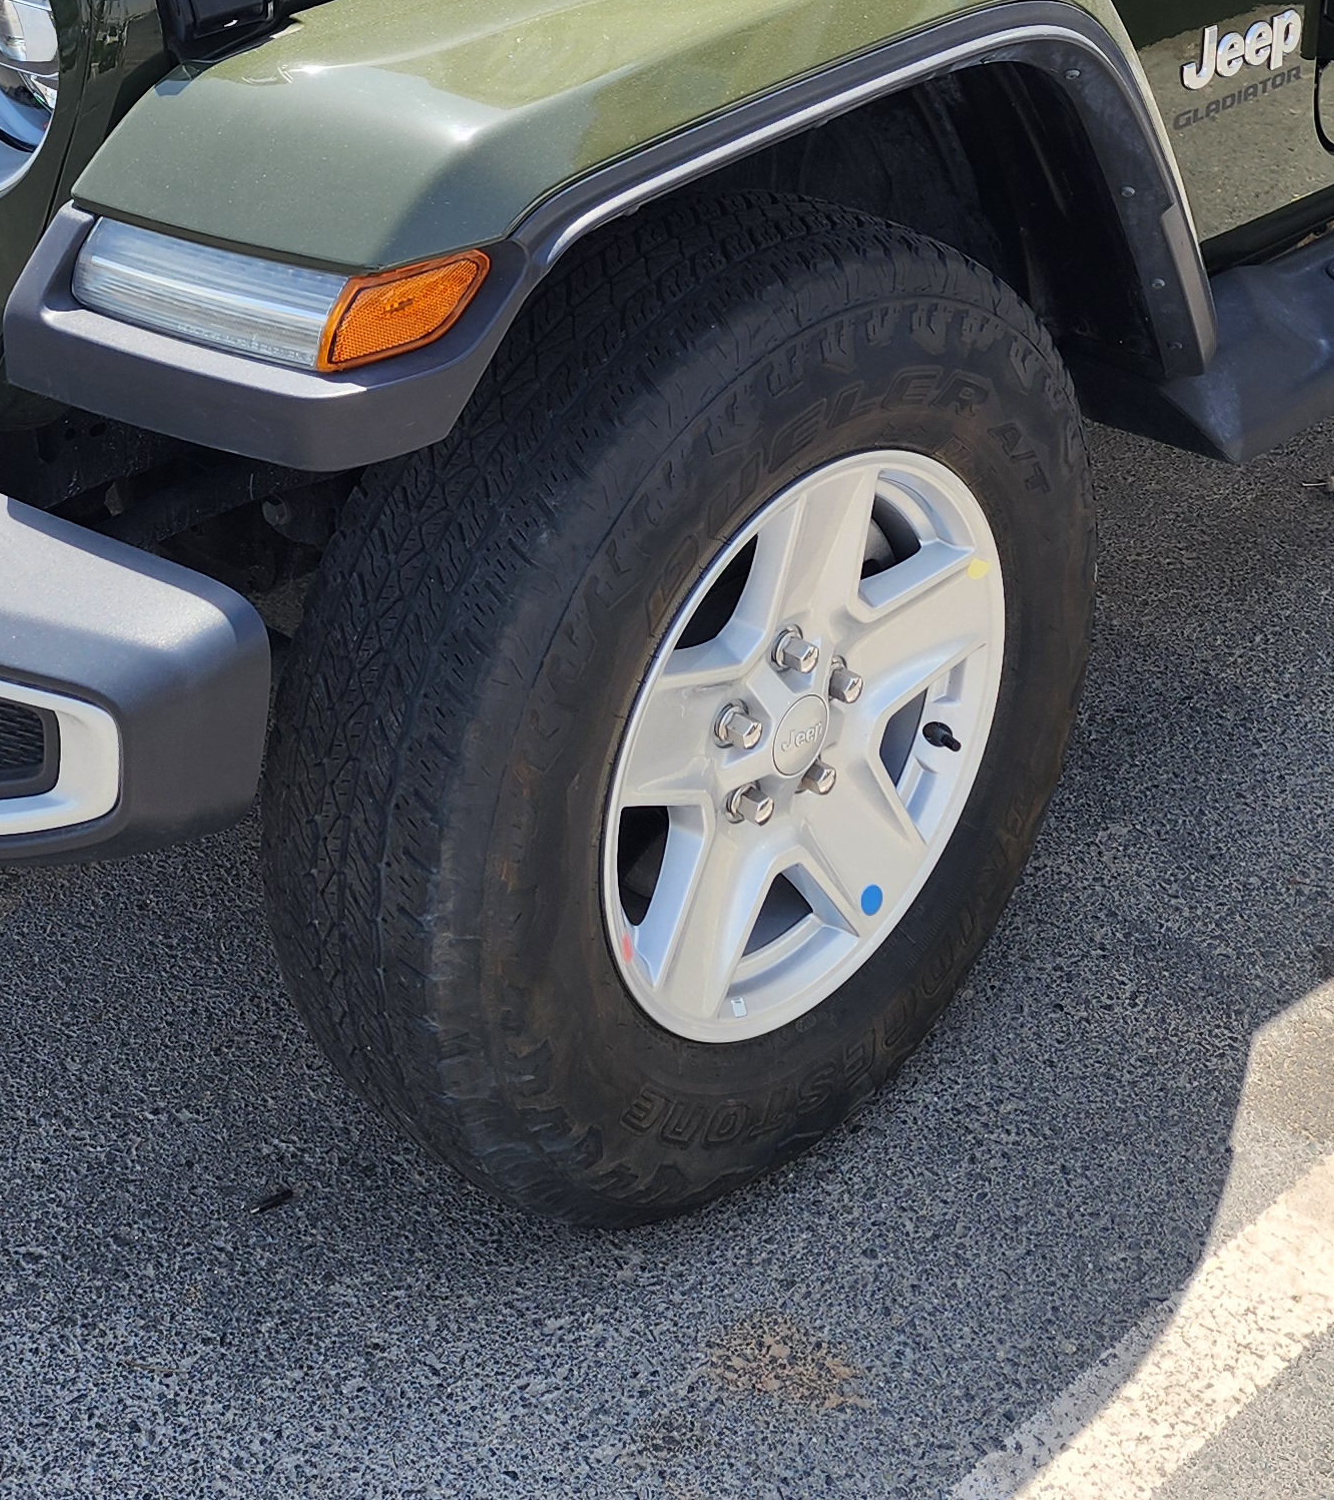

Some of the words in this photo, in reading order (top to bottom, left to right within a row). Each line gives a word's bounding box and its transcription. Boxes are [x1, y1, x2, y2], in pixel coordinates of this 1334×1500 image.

[1181, 9, 1302, 91] Jeep
[1172, 65, 1302, 131] GLADIATOR
[781, 721, 823, 752] Jeep
